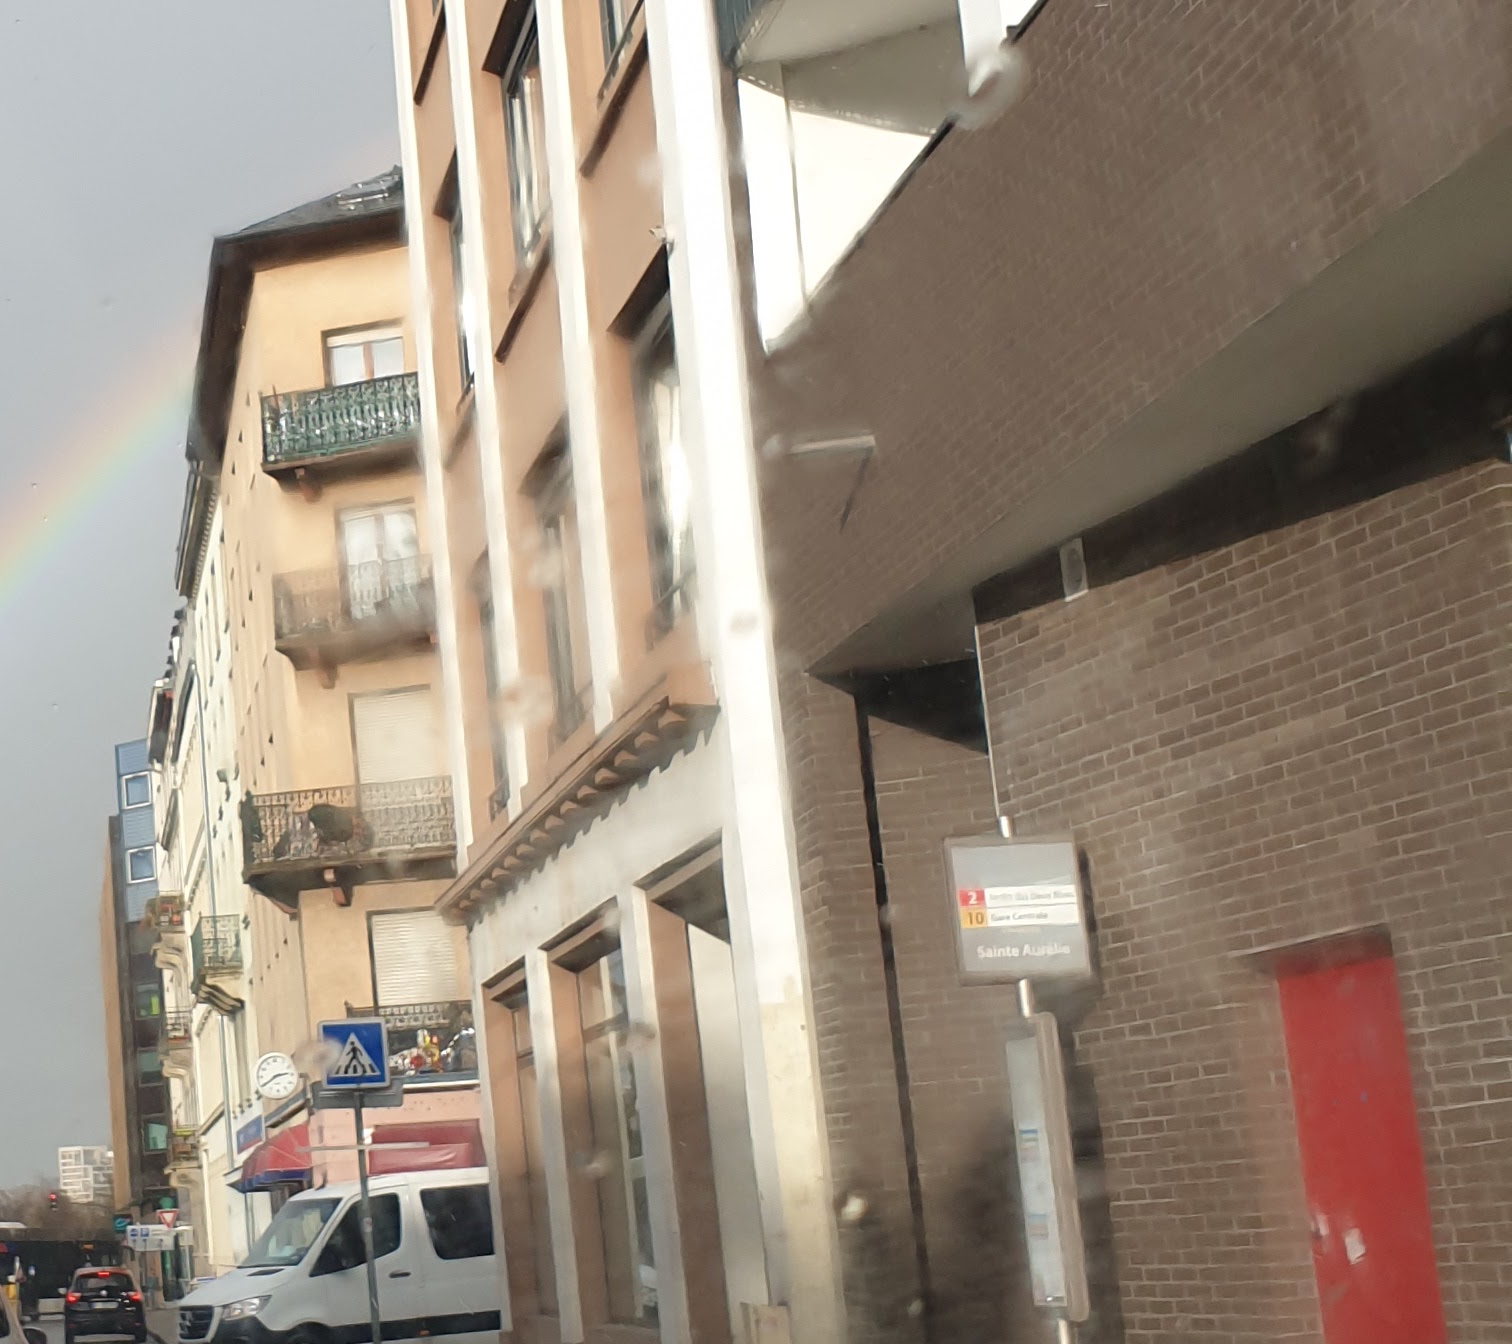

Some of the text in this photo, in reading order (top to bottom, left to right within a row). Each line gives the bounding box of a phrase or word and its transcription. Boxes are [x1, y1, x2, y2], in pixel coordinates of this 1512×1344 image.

[967, 891, 978, 905] 2
[968, 912, 985, 925] 10
[976, 945, 1020, 960] Sainte
